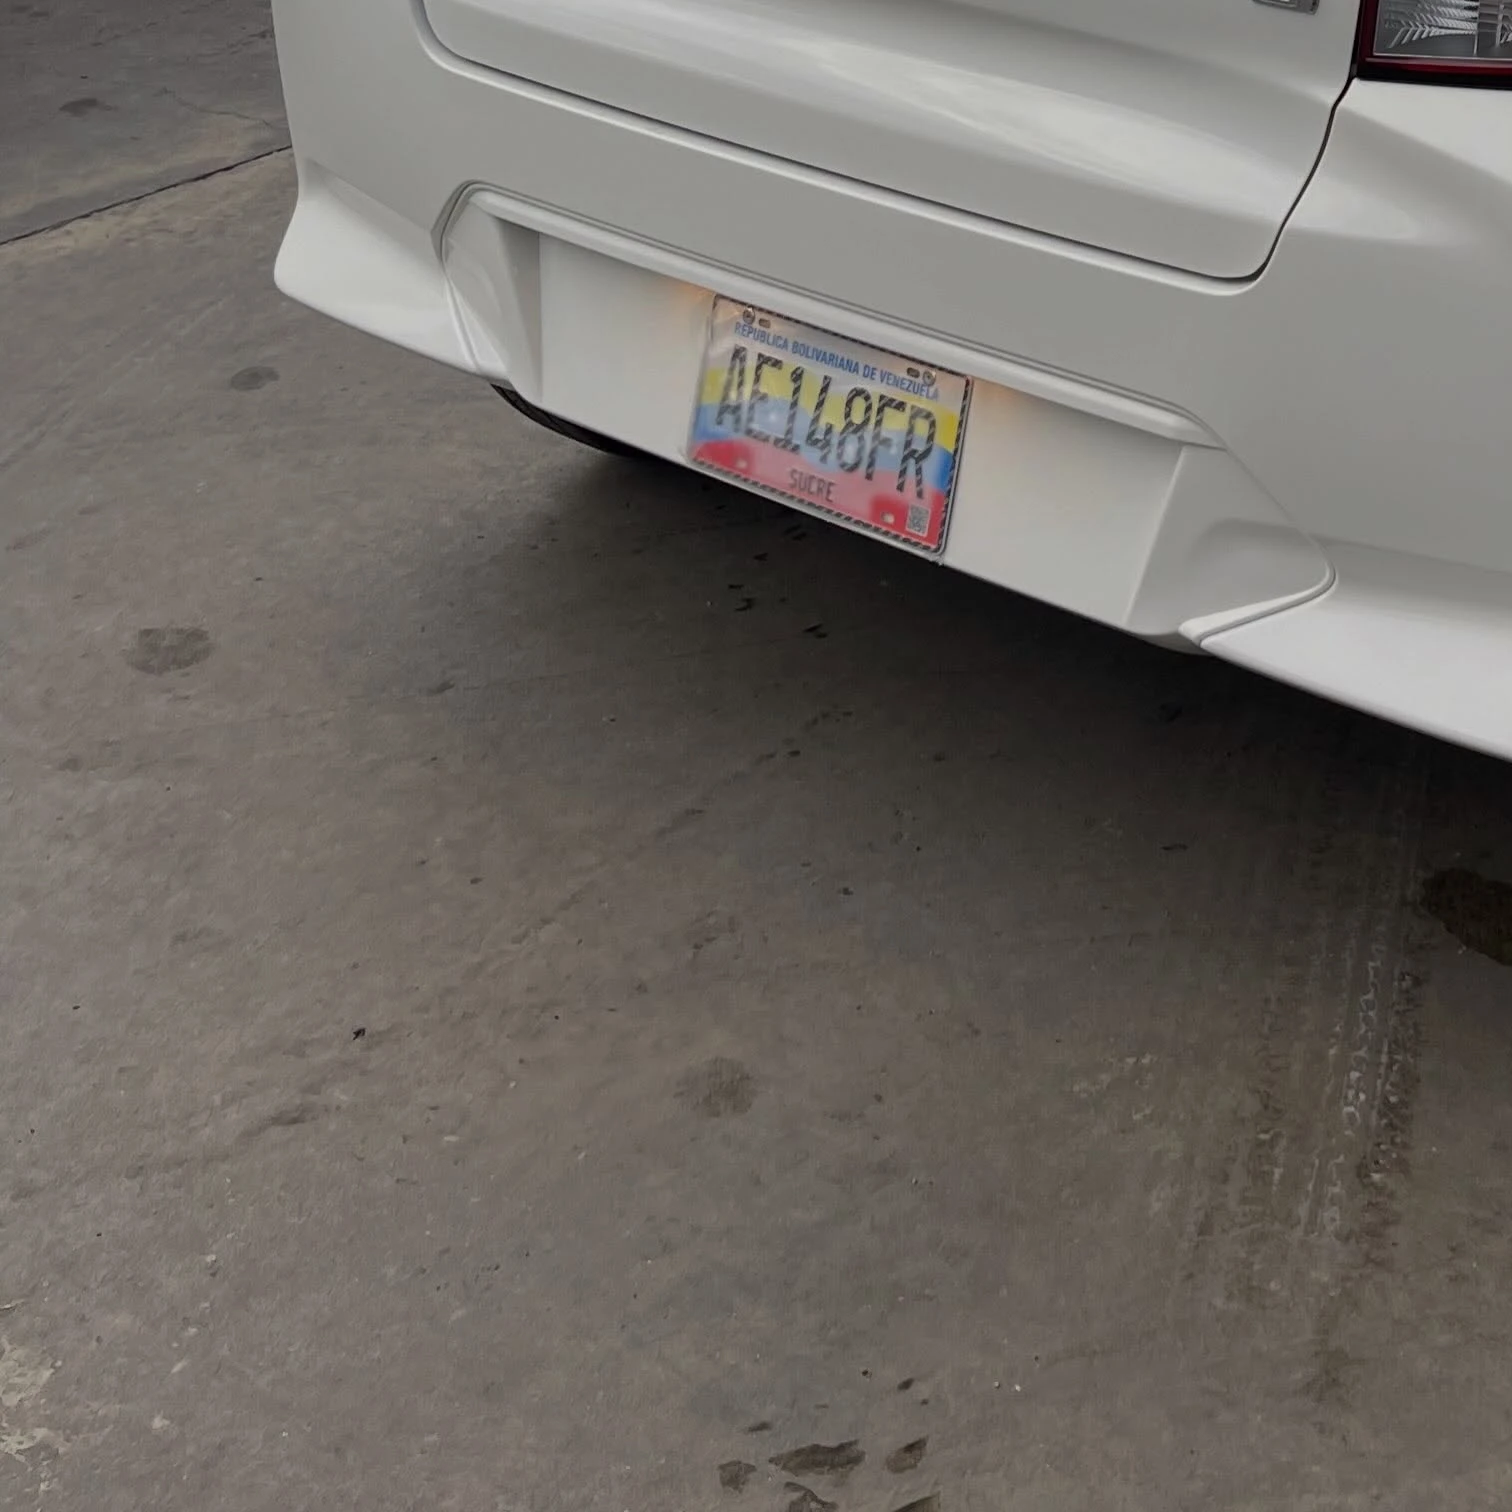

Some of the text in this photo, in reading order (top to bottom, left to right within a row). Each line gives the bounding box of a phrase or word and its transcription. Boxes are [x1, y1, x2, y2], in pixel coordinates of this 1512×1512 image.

[791, 340, 861, 375] BOLIVARIANA
[862, 364, 878, 381] DE
[879, 370, 940, 402] VENEZUELA
[715, 344, 937, 500] AE148FR
[787, 468, 836, 504] SUCRE
